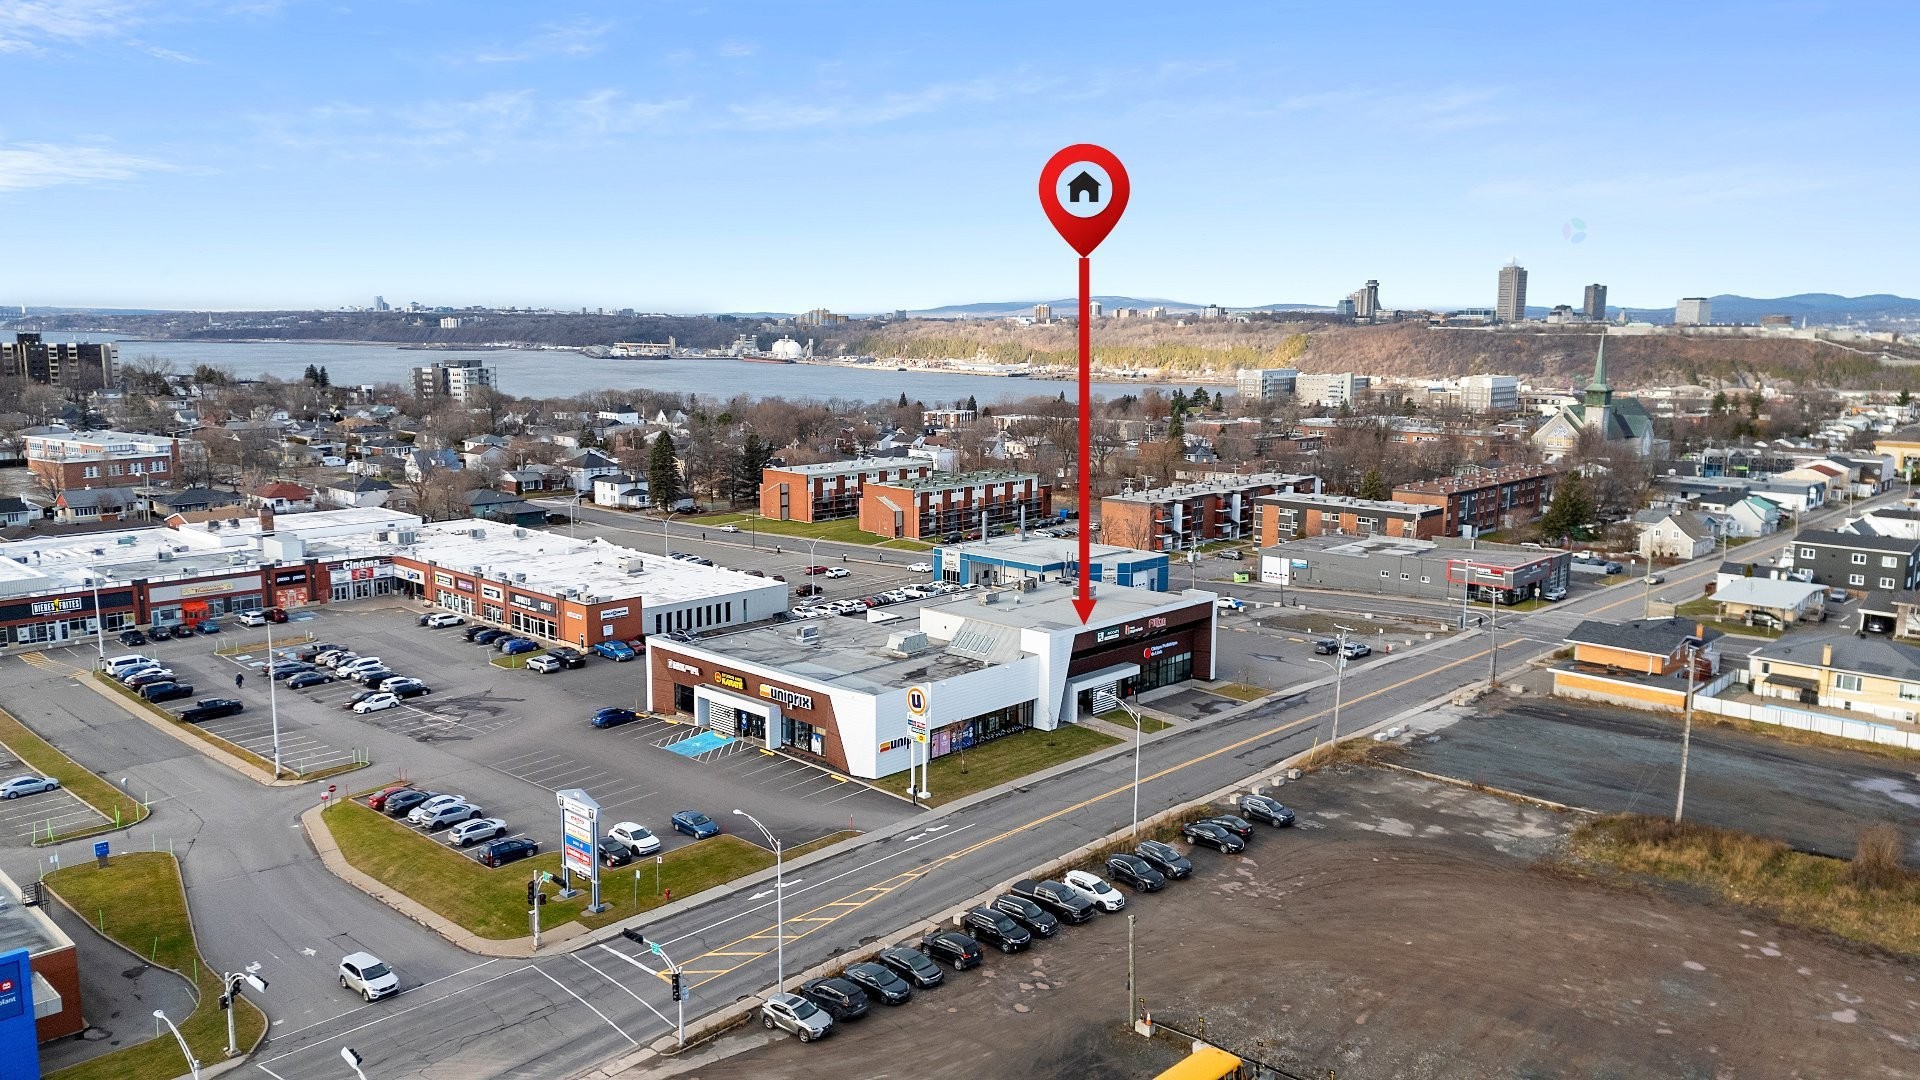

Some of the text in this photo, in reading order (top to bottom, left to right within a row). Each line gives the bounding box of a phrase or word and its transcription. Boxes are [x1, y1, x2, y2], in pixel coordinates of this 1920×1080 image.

[342, 559, 381, 570] Cinéma
[770, 688, 810, 708] uniprix
[890, 736, 912, 750] unip
[0, 996, 17, 1006] olant
